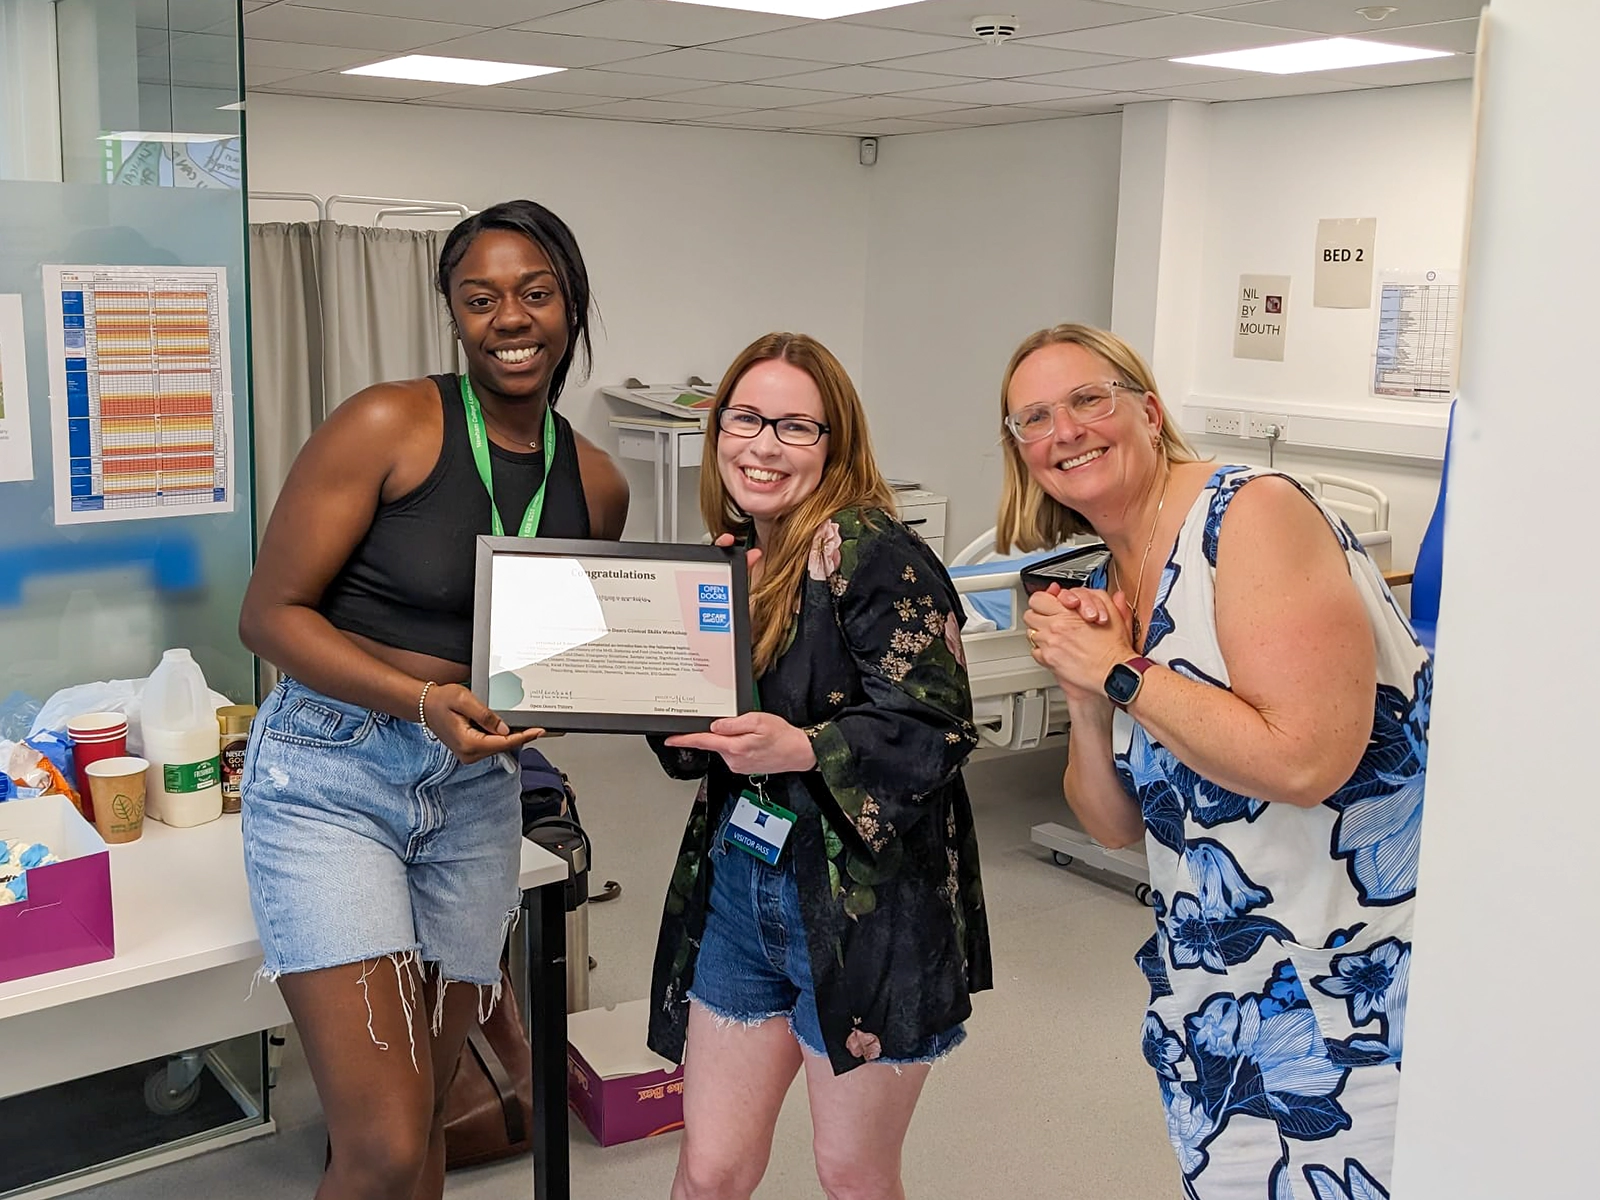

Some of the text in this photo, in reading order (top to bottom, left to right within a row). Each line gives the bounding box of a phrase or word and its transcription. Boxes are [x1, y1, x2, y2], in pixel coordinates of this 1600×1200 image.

[1324, 249, 1364, 262] BED 2
[1243, 288, 1259, 299] NIL
[1242, 306, 1256, 316] BY
[1240, 323, 1280, 335] MOUTH
[571, 568, 656, 581] Congratulations
[734, 832, 770, 855] VISITOR PASS
